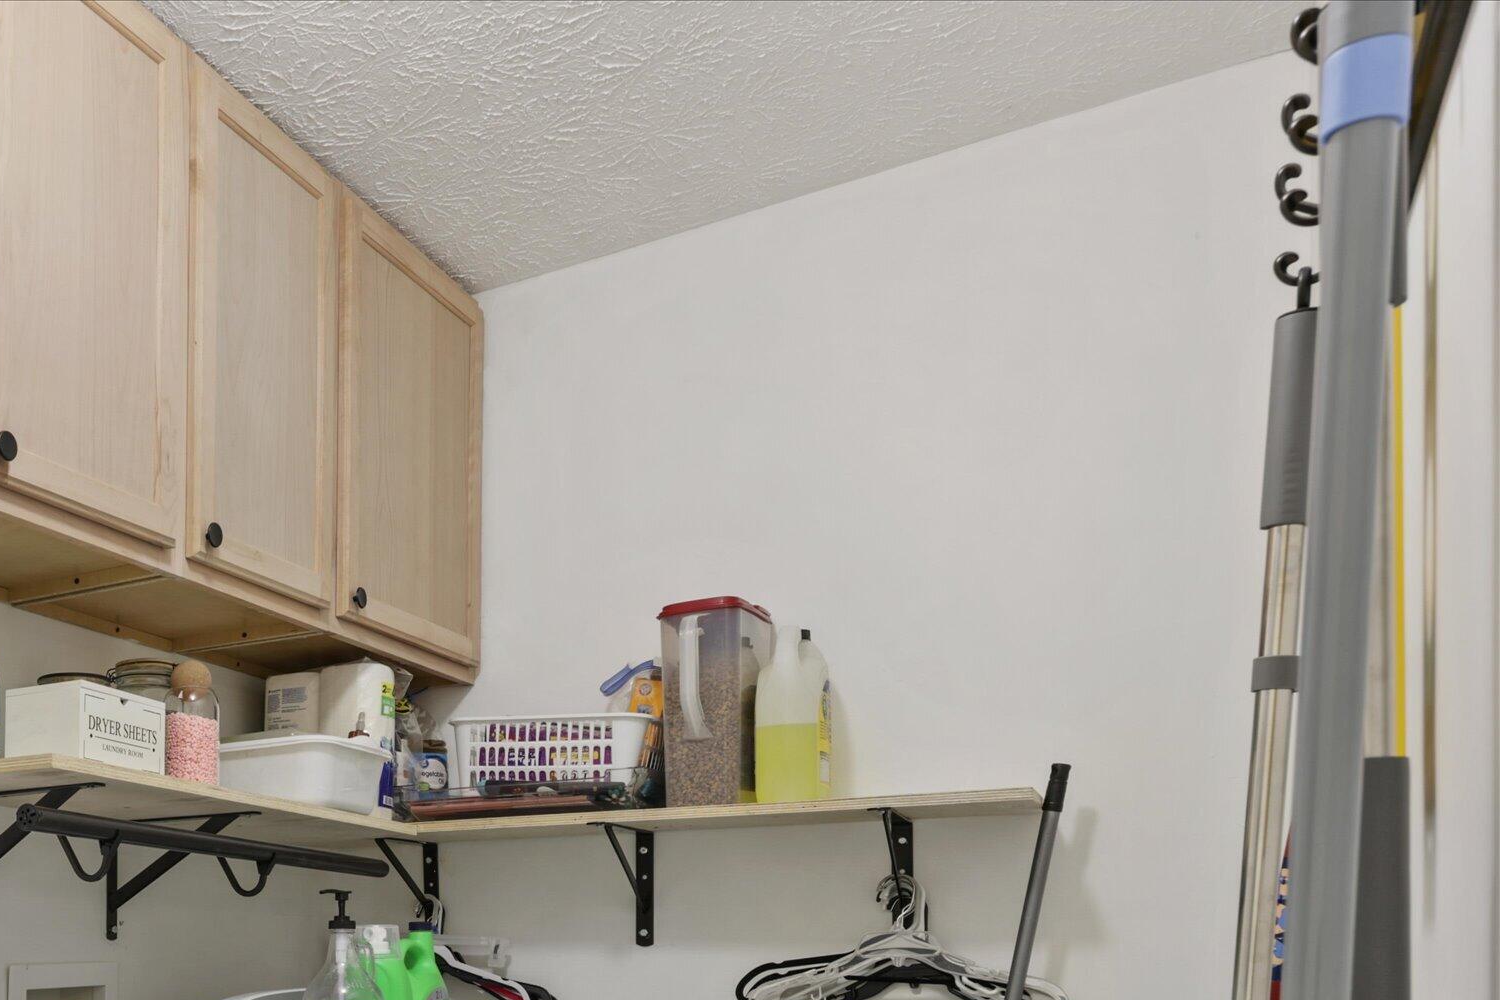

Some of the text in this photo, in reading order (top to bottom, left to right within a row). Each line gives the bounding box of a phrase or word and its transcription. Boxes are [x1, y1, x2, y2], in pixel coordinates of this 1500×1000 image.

[88, 714, 158, 746] DRYER SHEETS
[102, 743, 144, 759] LAUNDRY ROOM
[420, 768, 445, 779] egetable
